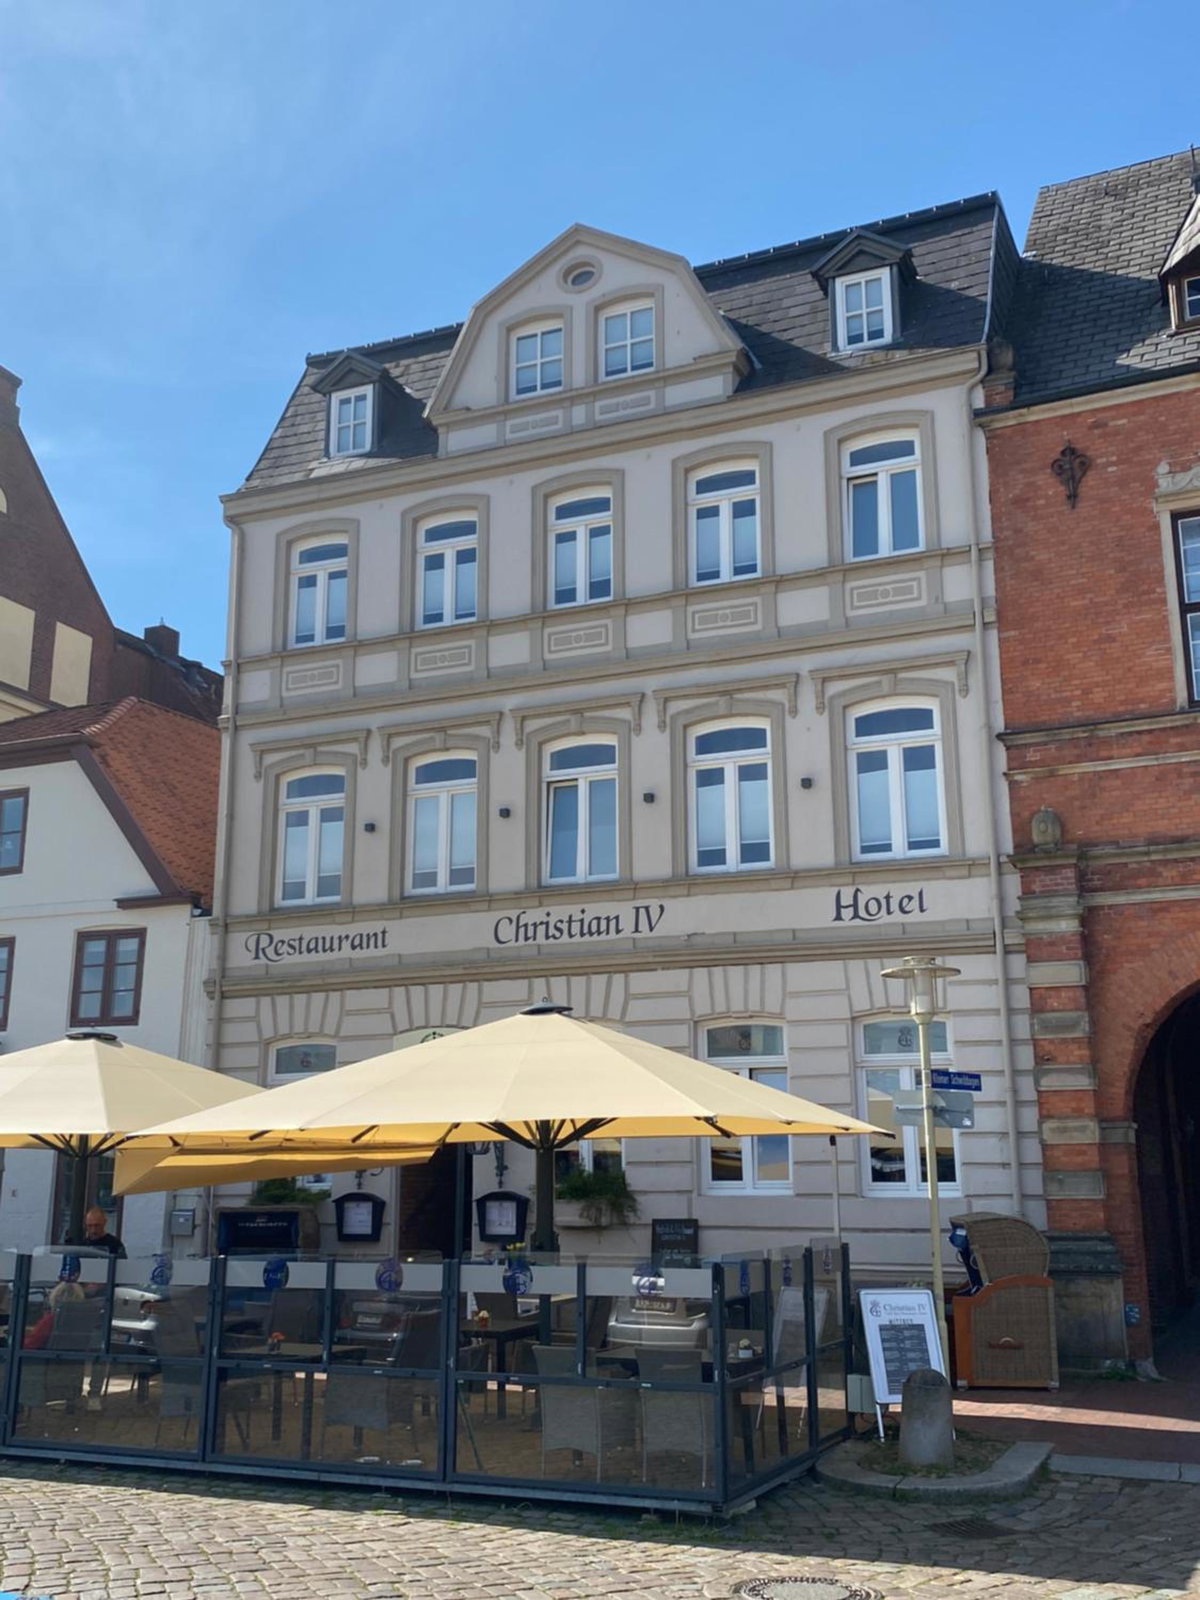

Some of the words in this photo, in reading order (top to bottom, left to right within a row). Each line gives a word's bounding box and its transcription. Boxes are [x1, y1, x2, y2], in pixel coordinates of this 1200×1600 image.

[493, 908, 625, 945] Christian
[631, 902, 666, 934] IV
[832, 887, 928, 922] Hotel
[244, 926, 389, 965] Restaurant
